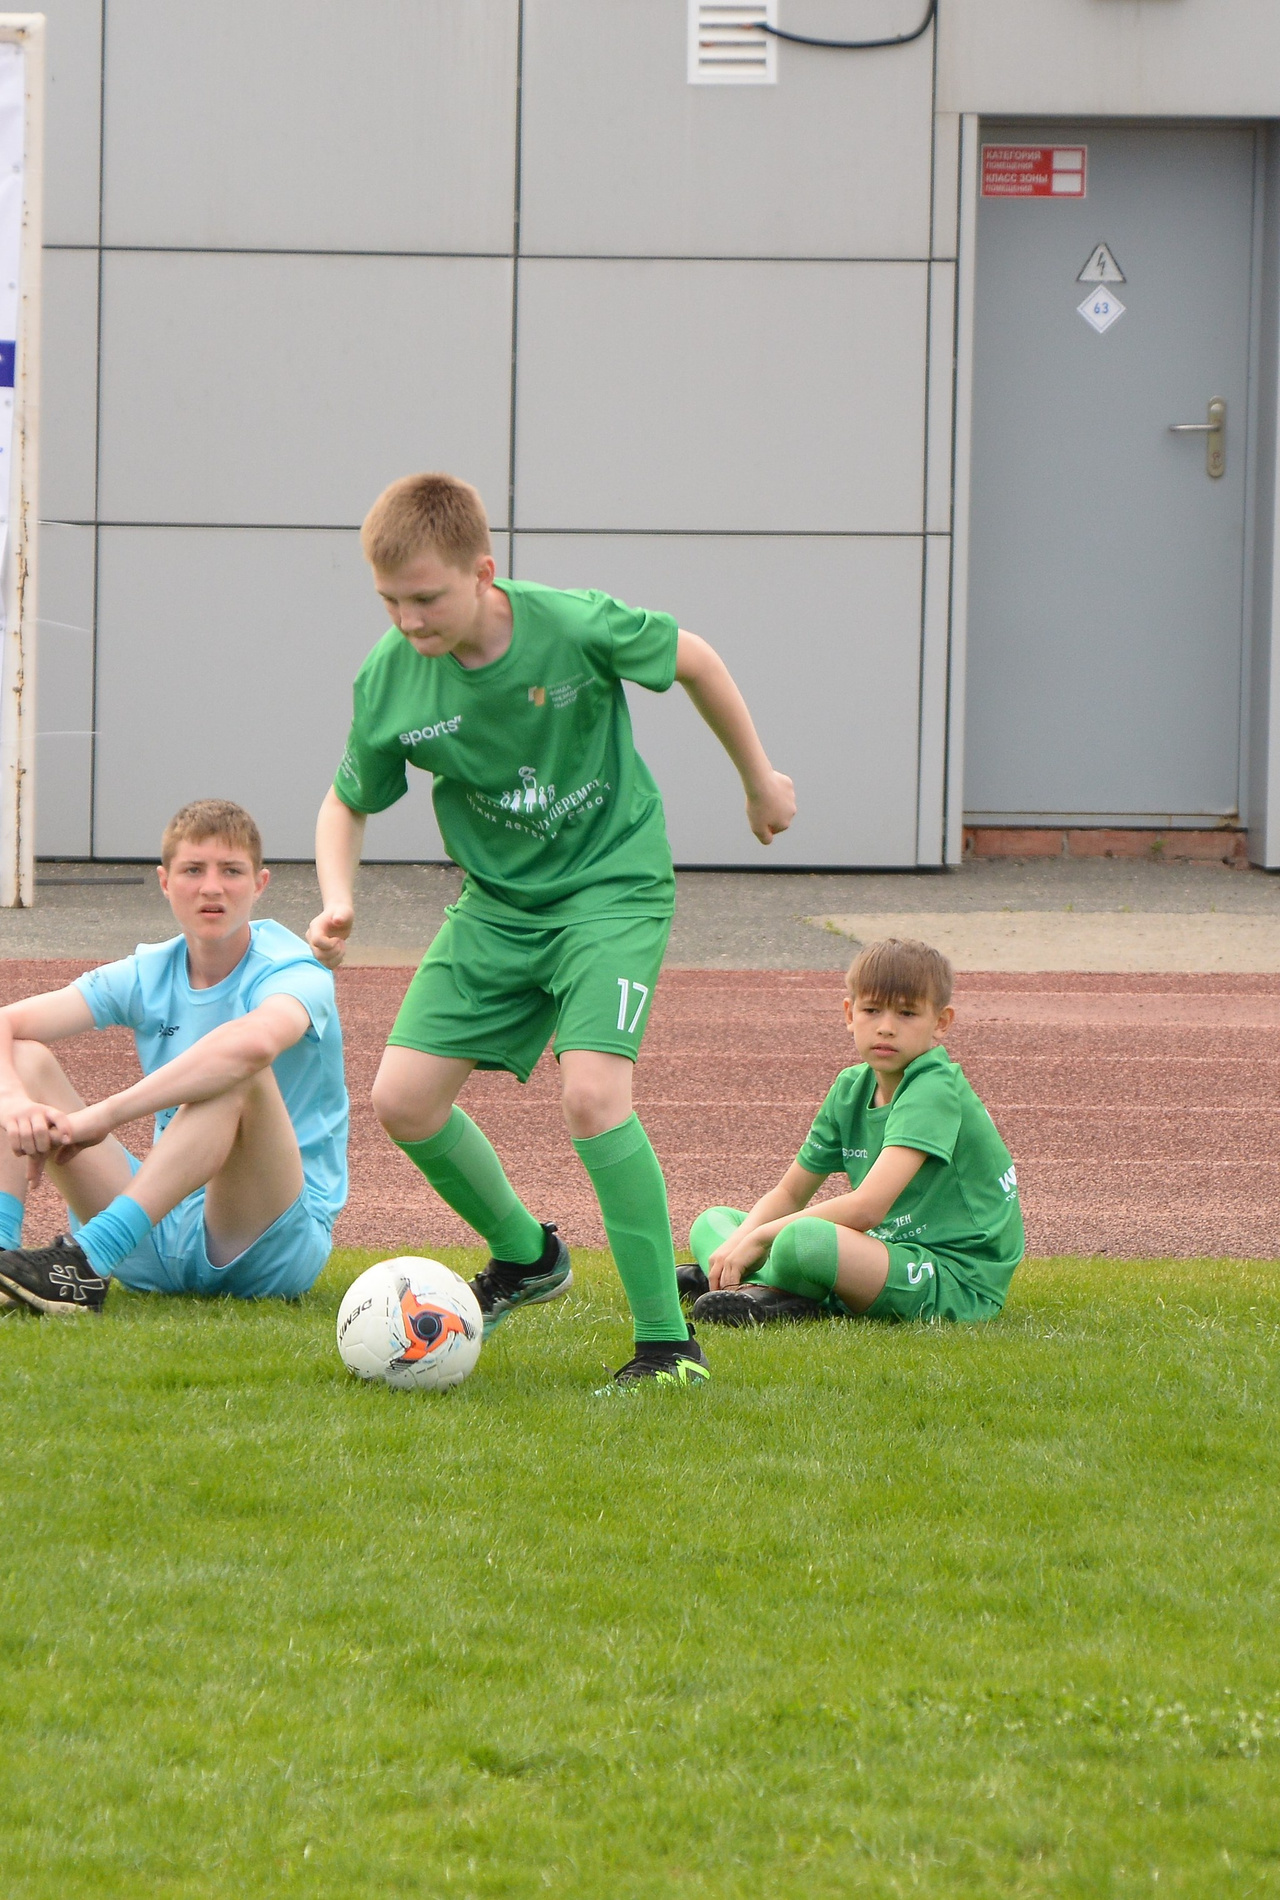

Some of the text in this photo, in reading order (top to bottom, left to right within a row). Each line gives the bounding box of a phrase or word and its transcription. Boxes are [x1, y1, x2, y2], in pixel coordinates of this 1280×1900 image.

[986, 173, 1049, 184] КЛАСС ЗОНЫ
[1094, 302, 1109, 314] 63
[617, 977, 649, 1034] 17
[842, 1147, 868, 1159] sport
[907, 1261, 934, 1285] 5
